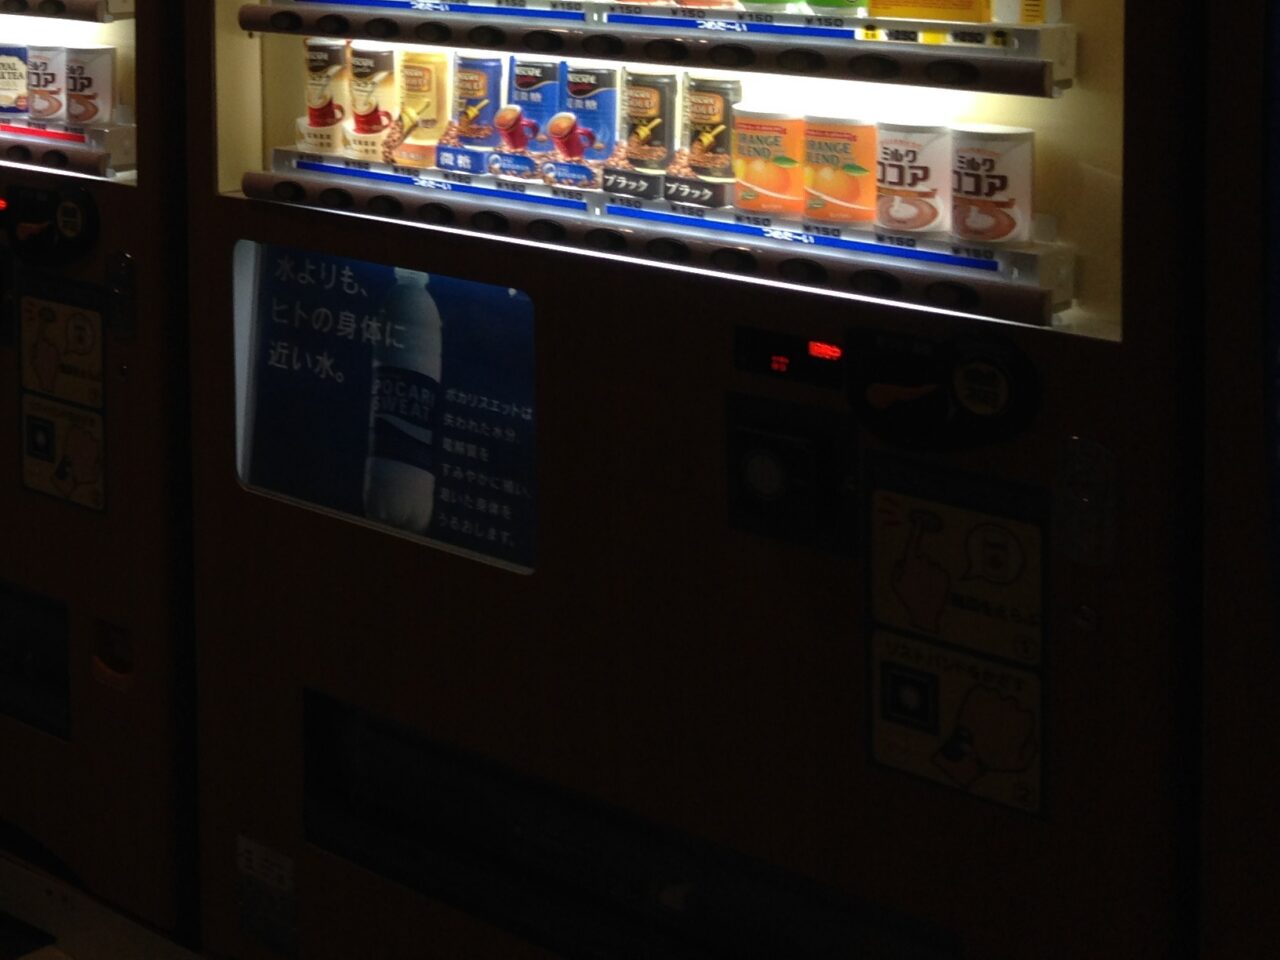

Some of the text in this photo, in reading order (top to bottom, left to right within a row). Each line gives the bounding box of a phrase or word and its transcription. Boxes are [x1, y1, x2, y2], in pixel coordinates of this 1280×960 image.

[440, 152, 472, 170] 微糖
[881, 146, 917, 163] ミルク
[957, 155, 995, 172] ミルク
[604, 175, 649, 192] ブラック
[665, 182, 713, 200] ブラック
[275, 257, 368, 297] 水よりも、
[271, 297, 406, 350] ヒトの身体に
[267, 340, 344, 383] 近い水。
